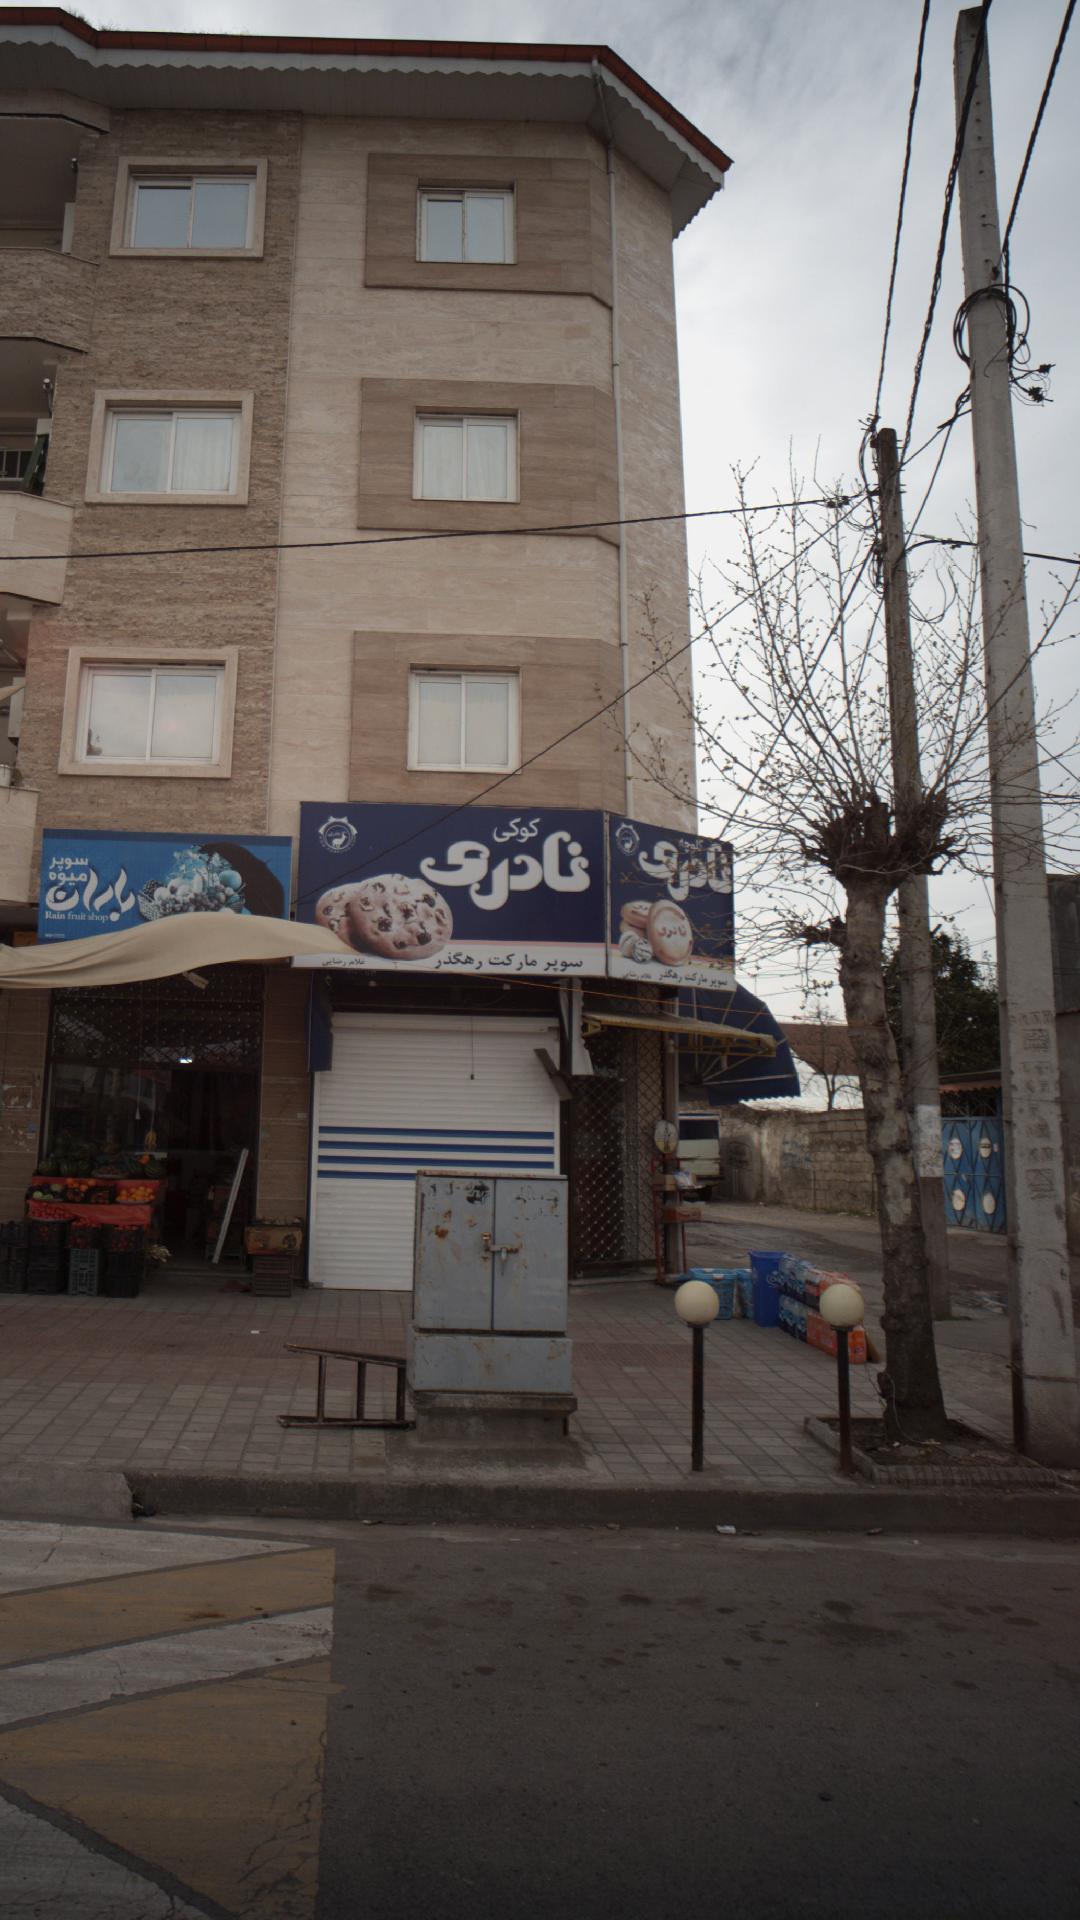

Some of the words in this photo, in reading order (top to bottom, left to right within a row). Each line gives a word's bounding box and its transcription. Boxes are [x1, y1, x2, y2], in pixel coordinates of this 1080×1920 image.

[493, 817, 542, 843] کوکی
[49, 856, 89, 872] سوپر
[419, 830, 591, 911] نادری
[48, 871, 88, 886] میوه
[45, 867, 136, 922] باران
[45, 911, 66, 920] Rain
[67, 911, 87, 920] fruit
[87, 912, 109, 923] shop
[434, 951, 483, 970] رهگذر
[488, 953, 538, 971] مارکت
[543, 959, 584, 973] سوپر
[709, 977, 728, 989] سوپر
